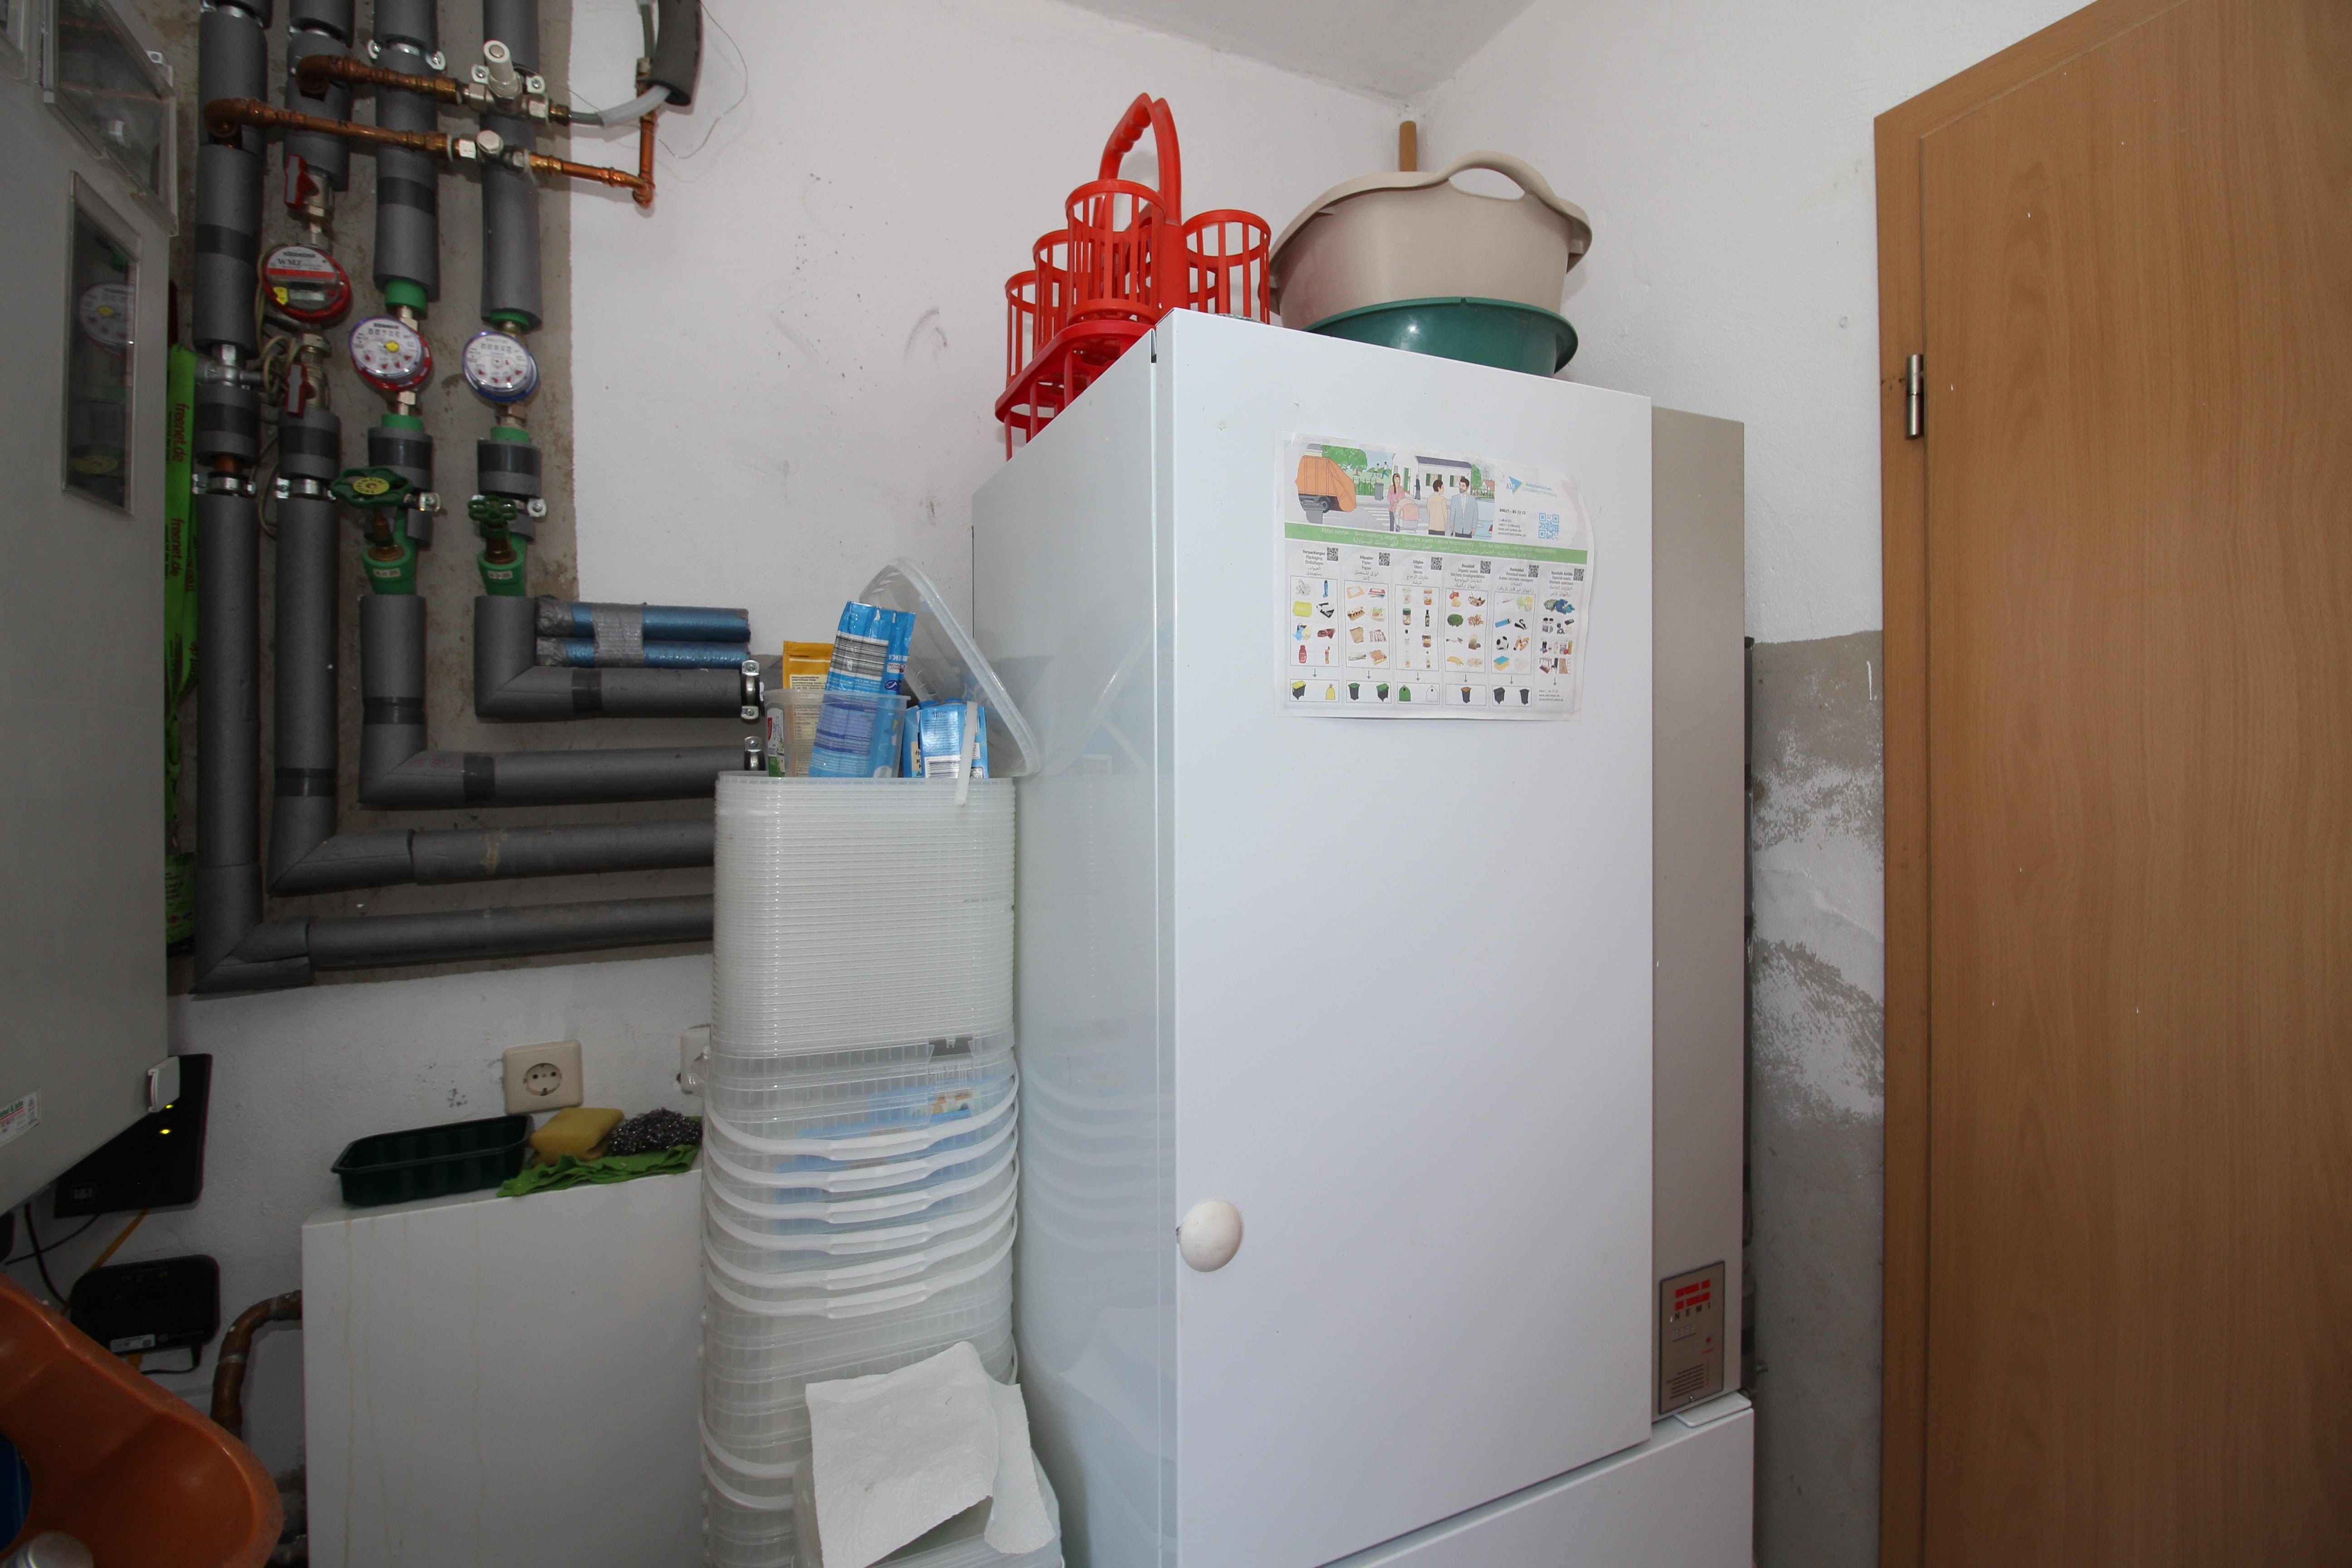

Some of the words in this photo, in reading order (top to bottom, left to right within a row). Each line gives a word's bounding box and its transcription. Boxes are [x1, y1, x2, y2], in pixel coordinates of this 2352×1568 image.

[173, 402, 190, 461] freenet.de
[171, 517, 185, 577] freenet.de
[1675, 1302, 1710, 1320] NEMI
